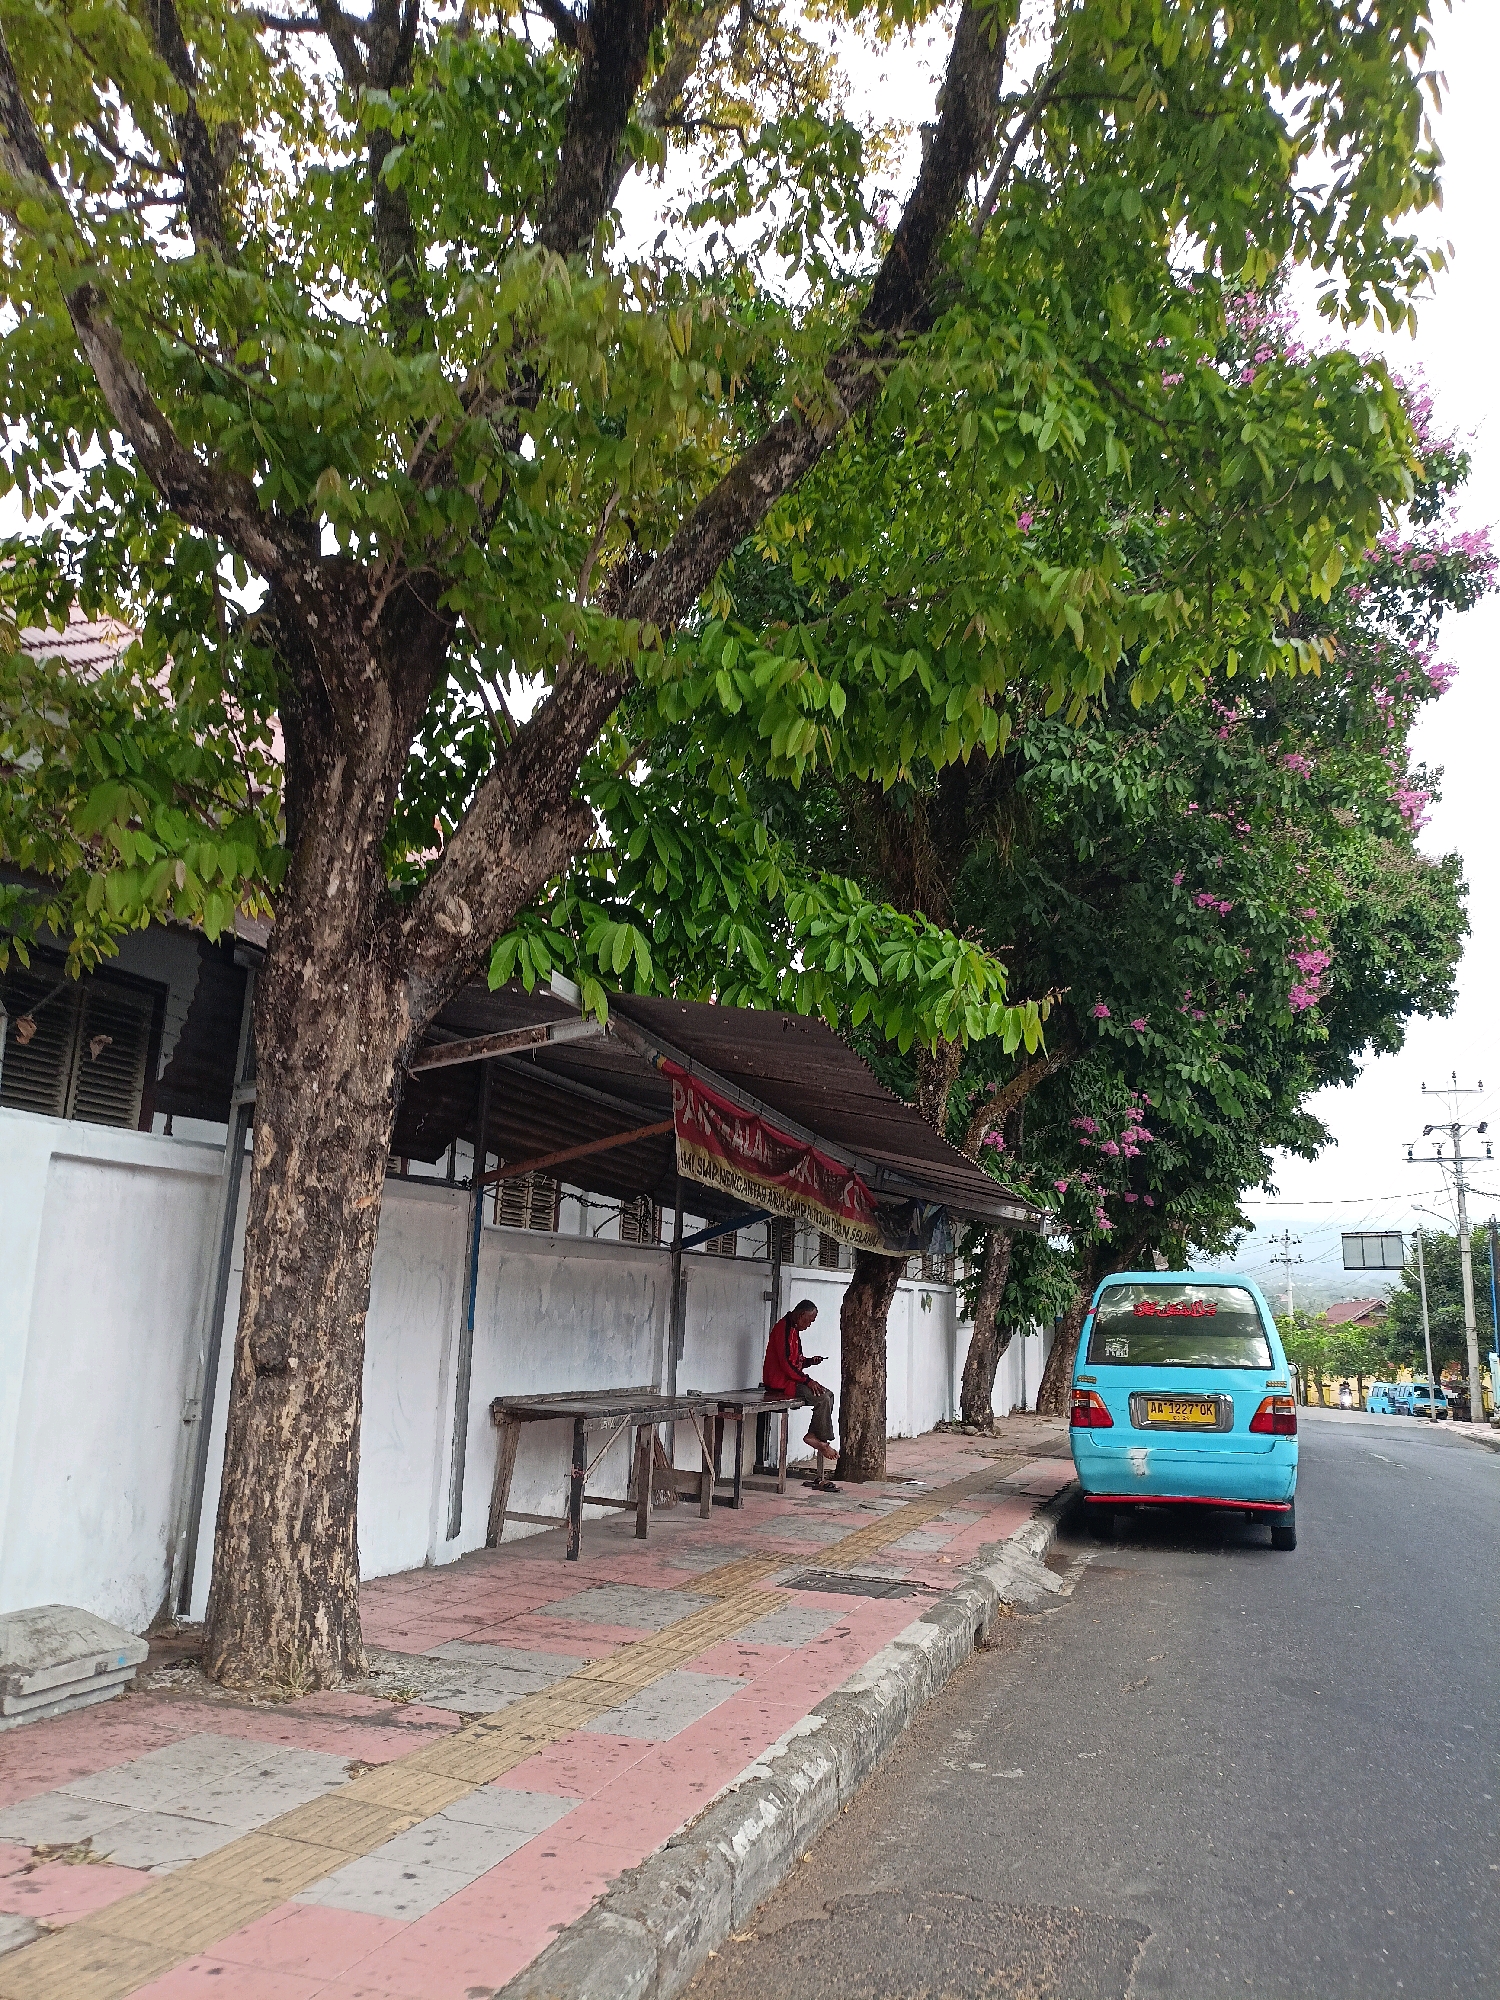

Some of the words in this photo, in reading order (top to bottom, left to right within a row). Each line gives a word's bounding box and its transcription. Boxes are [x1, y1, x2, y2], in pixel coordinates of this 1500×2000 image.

[672, 1079, 773, 1167] PANALAN
[1151, 1402, 1164, 1415] AA
[1168, 1402, 1194, 1416] 1227
